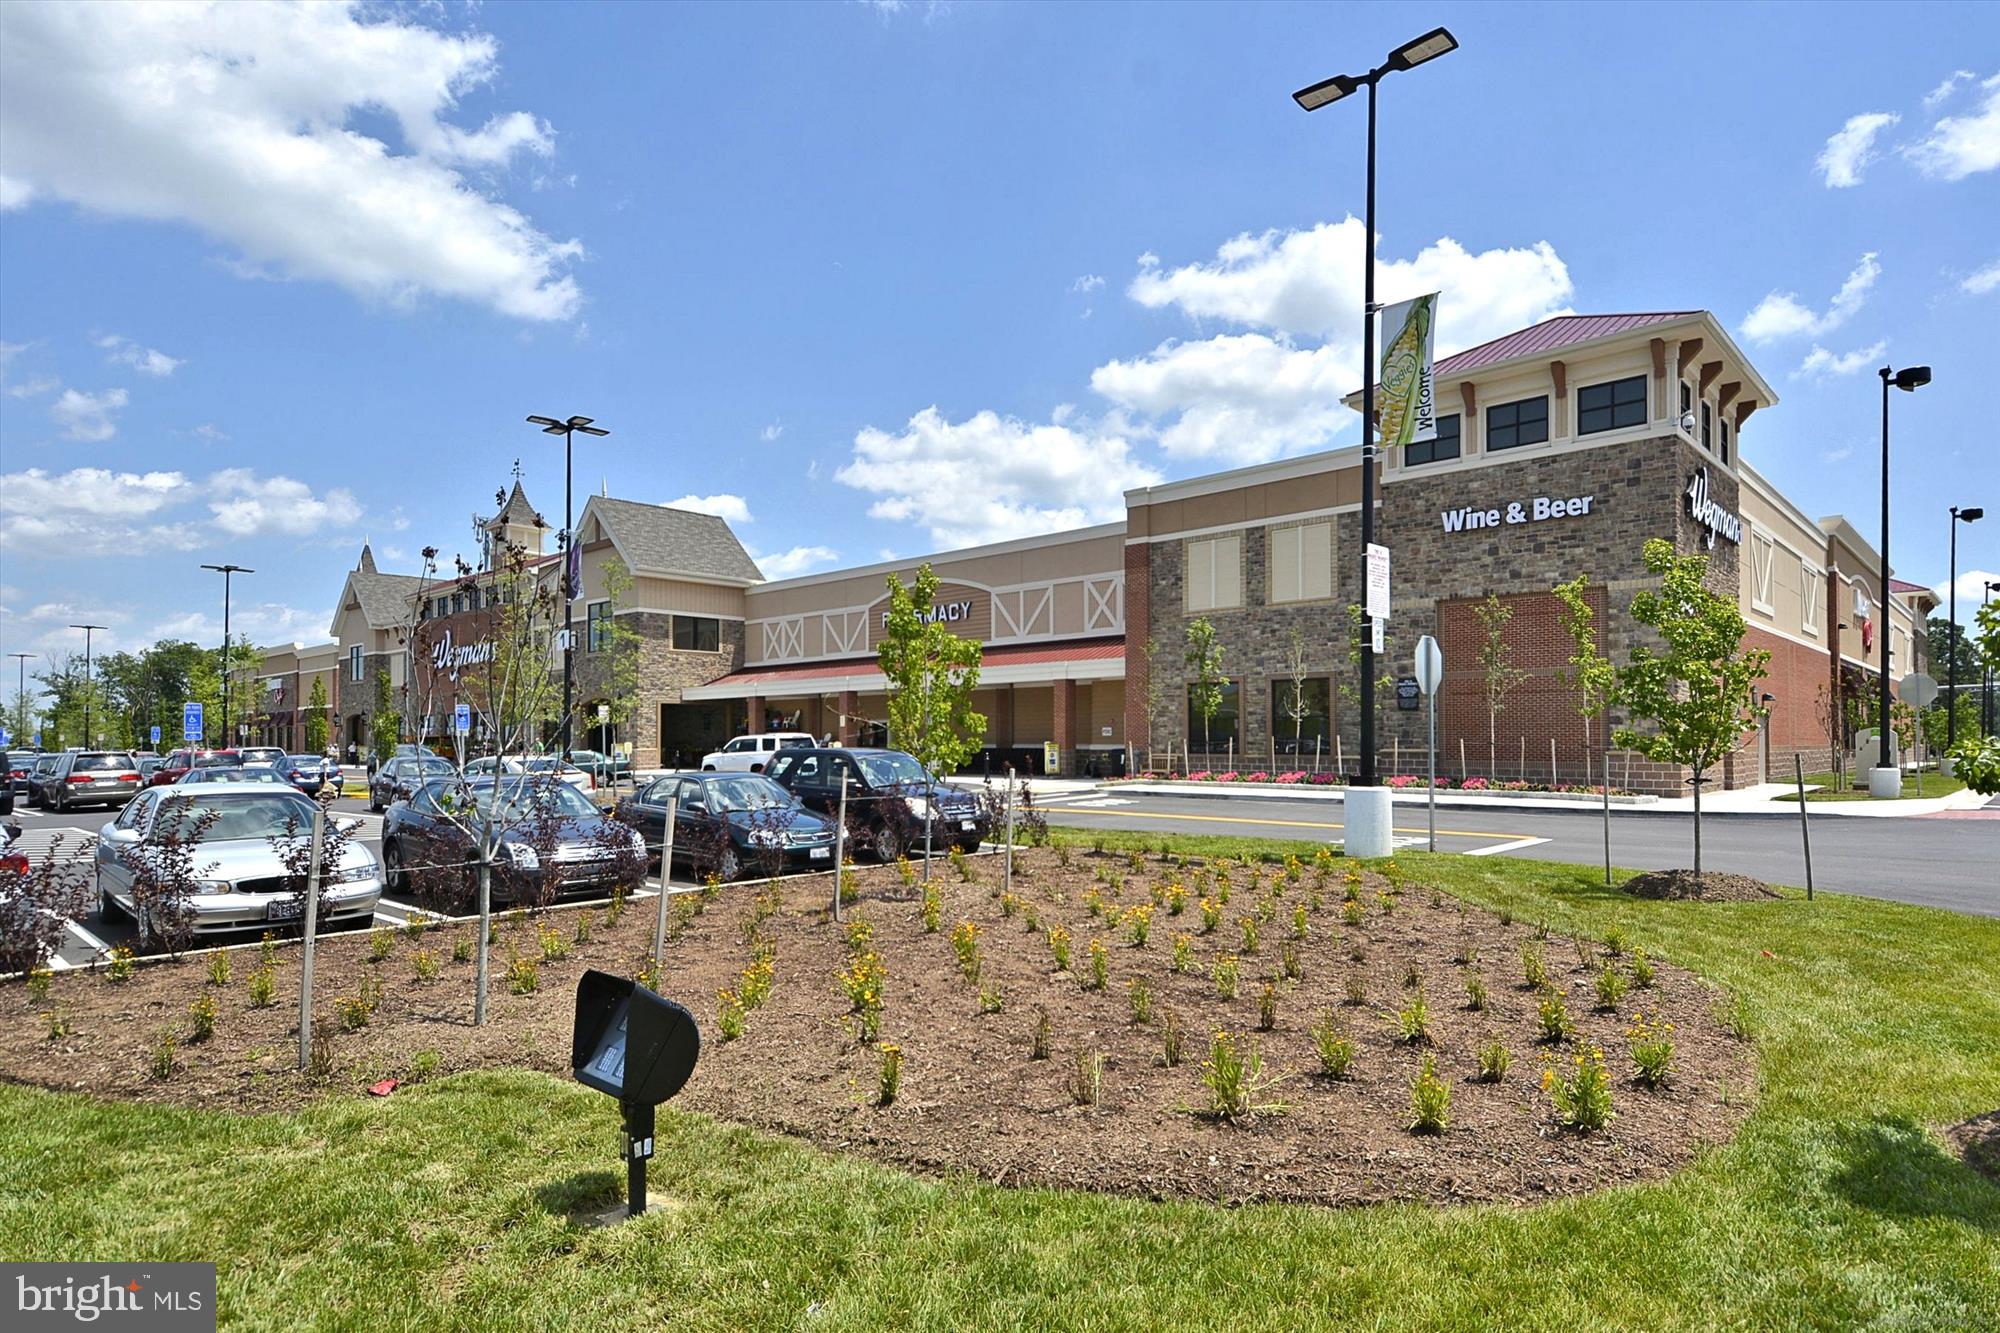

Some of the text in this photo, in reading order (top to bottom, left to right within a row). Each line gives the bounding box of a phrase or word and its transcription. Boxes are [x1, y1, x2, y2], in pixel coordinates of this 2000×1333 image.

[1383, 360, 1415, 390] Veggies
[1414, 366, 1433, 431] Welcome
[1441, 495, 1594, 533] Wine & Beer
[1686, 466, 1743, 550] Wegmans
[881, 601, 971, 628] PRMACY
